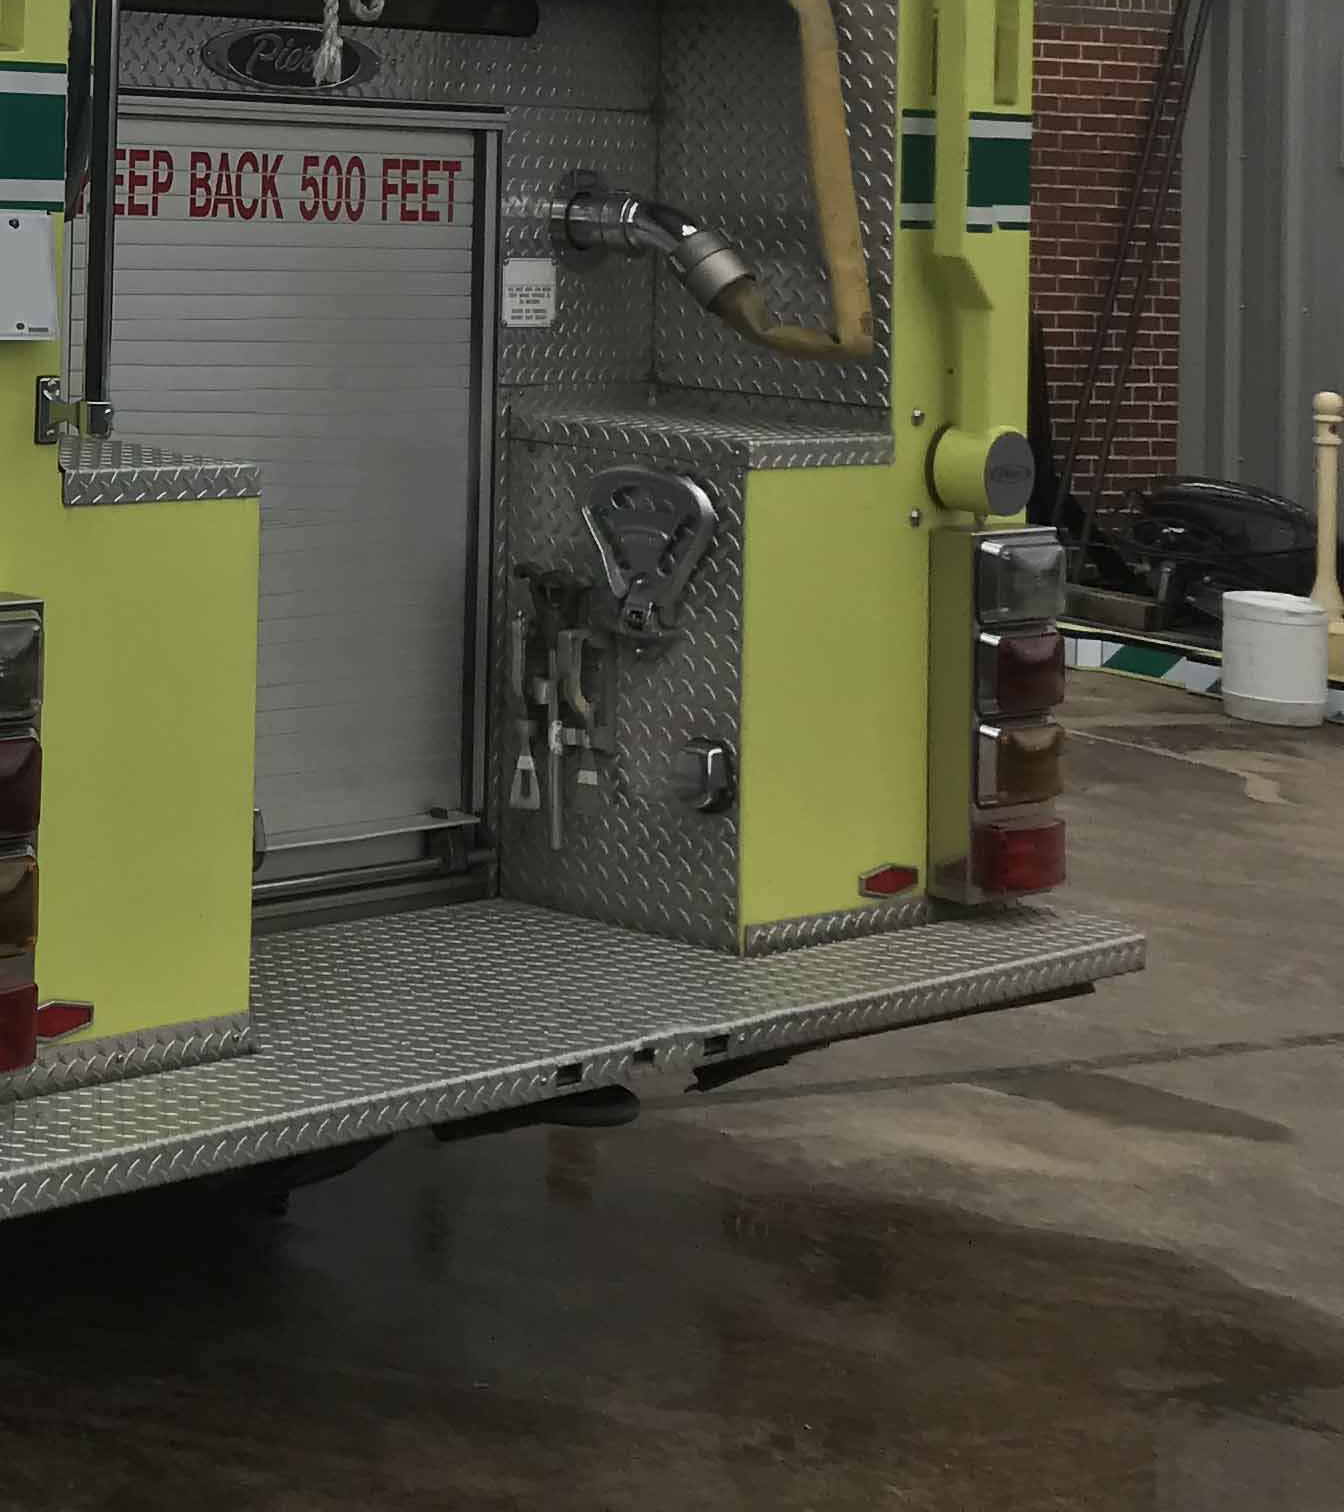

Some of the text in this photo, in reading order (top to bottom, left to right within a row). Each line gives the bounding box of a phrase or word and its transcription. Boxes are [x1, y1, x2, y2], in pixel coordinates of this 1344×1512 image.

[245, 32, 320, 76] Pier
[77, 149, 462, 223] EEP BACK 500 FEET
